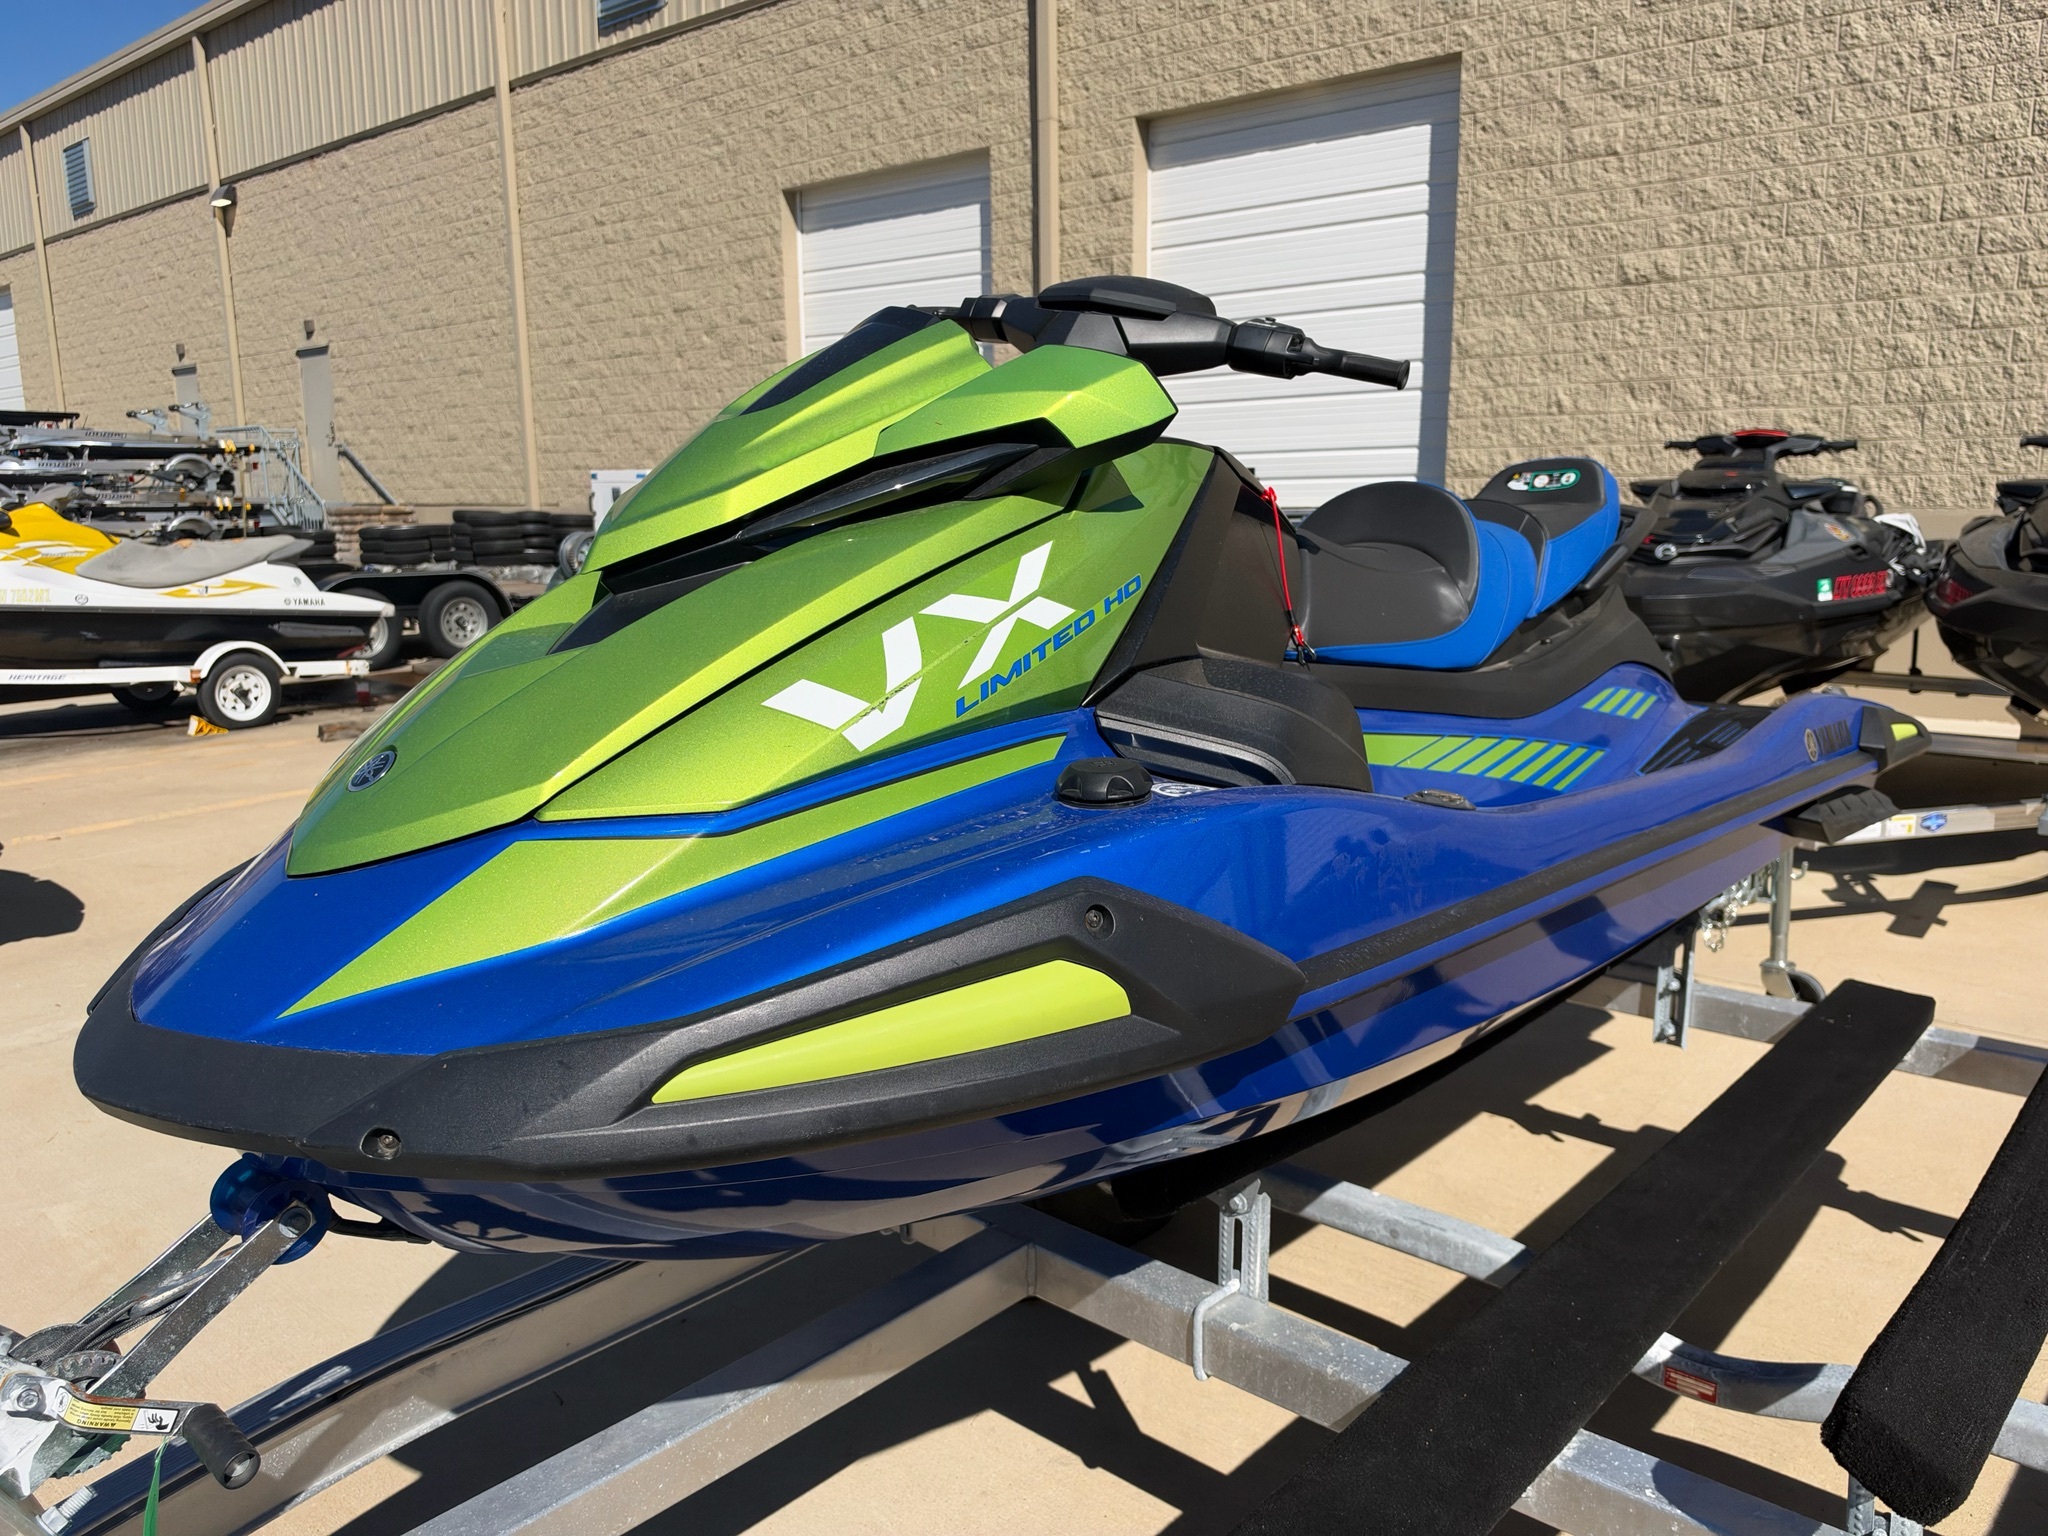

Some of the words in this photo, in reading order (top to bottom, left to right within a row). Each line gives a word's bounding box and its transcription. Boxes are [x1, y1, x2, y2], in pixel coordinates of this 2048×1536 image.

[292, 597, 326, 606] YAMAHA
[761, 541, 1077, 752] VX
[956, 609, 1095, 718] LIMITED
[1103, 573, 1142, 616] HO
[77, 1419, 110, 1427] WARNING
